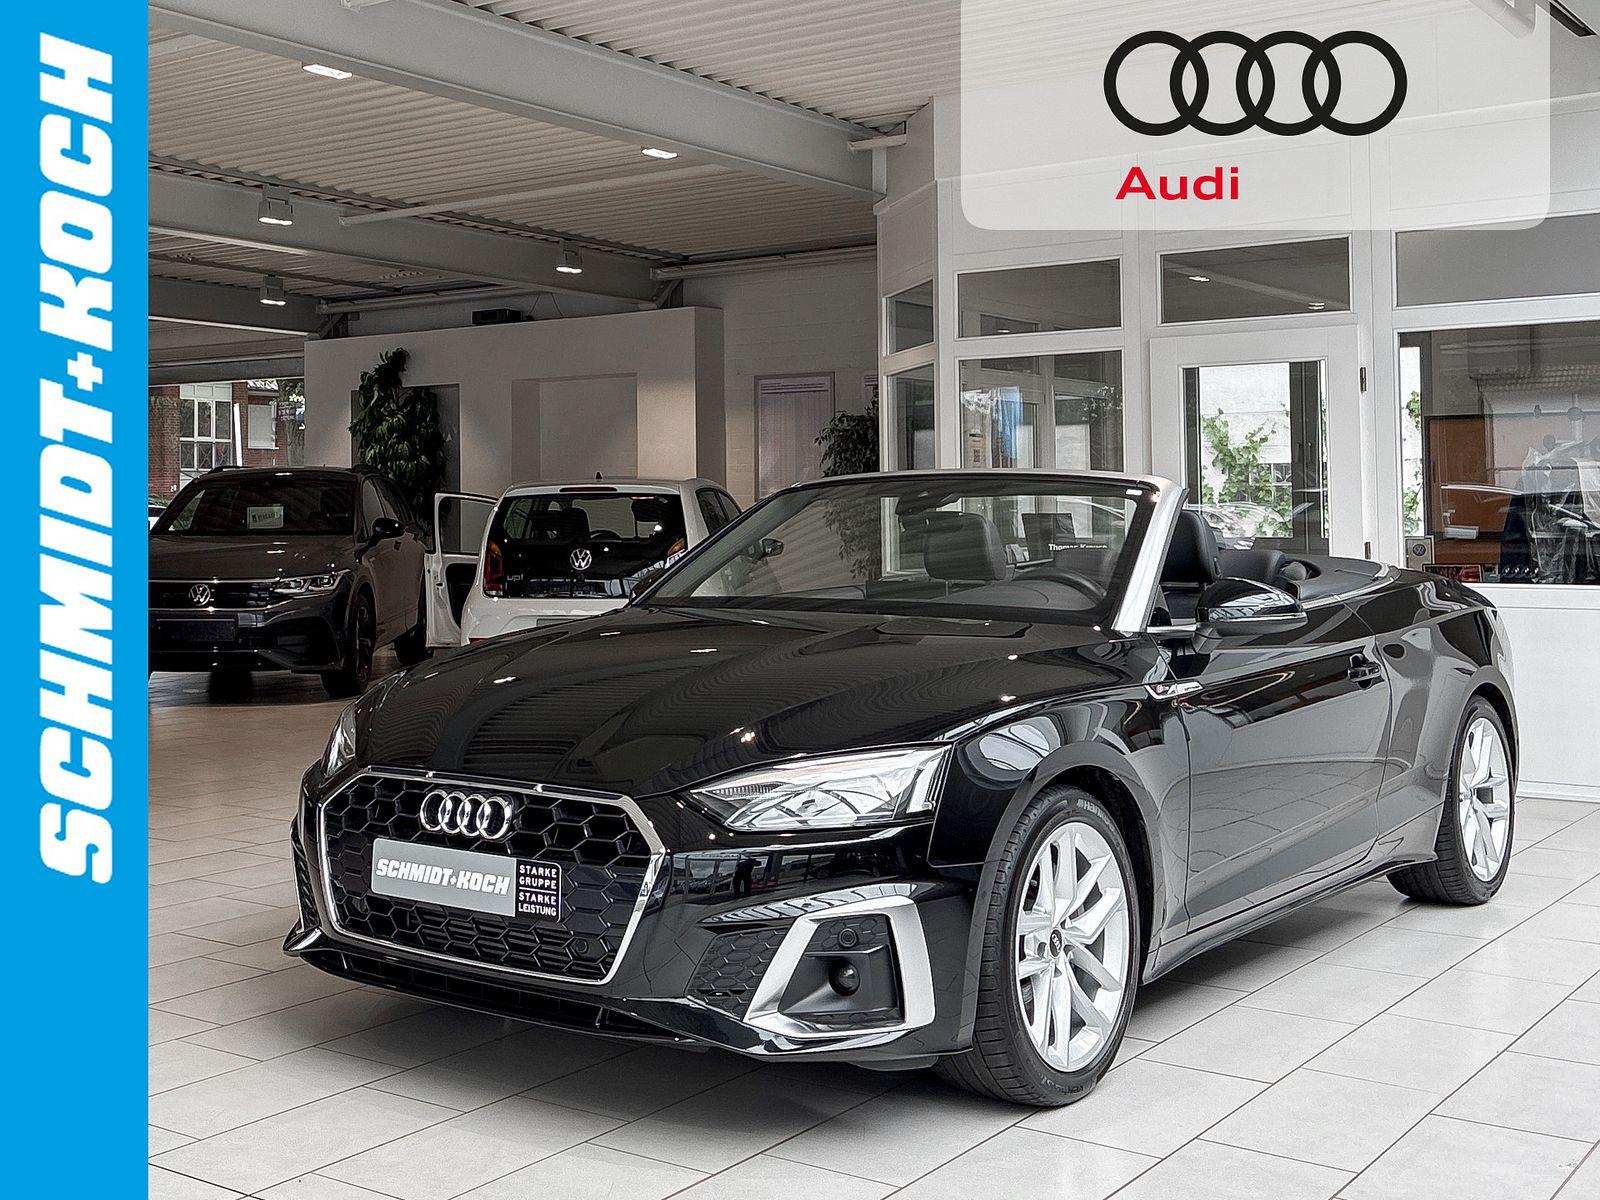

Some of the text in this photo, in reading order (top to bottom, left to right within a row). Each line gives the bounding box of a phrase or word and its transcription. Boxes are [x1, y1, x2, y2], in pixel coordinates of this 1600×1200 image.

[375, 858, 511, 895] SCHMIDT+KOCH
[519, 864, 557, 877] STARKE
[519, 875, 557, 890] GRUPPE
[518, 892, 557, 905] STARKE
[518, 903, 557, 917] LEISTUNG
